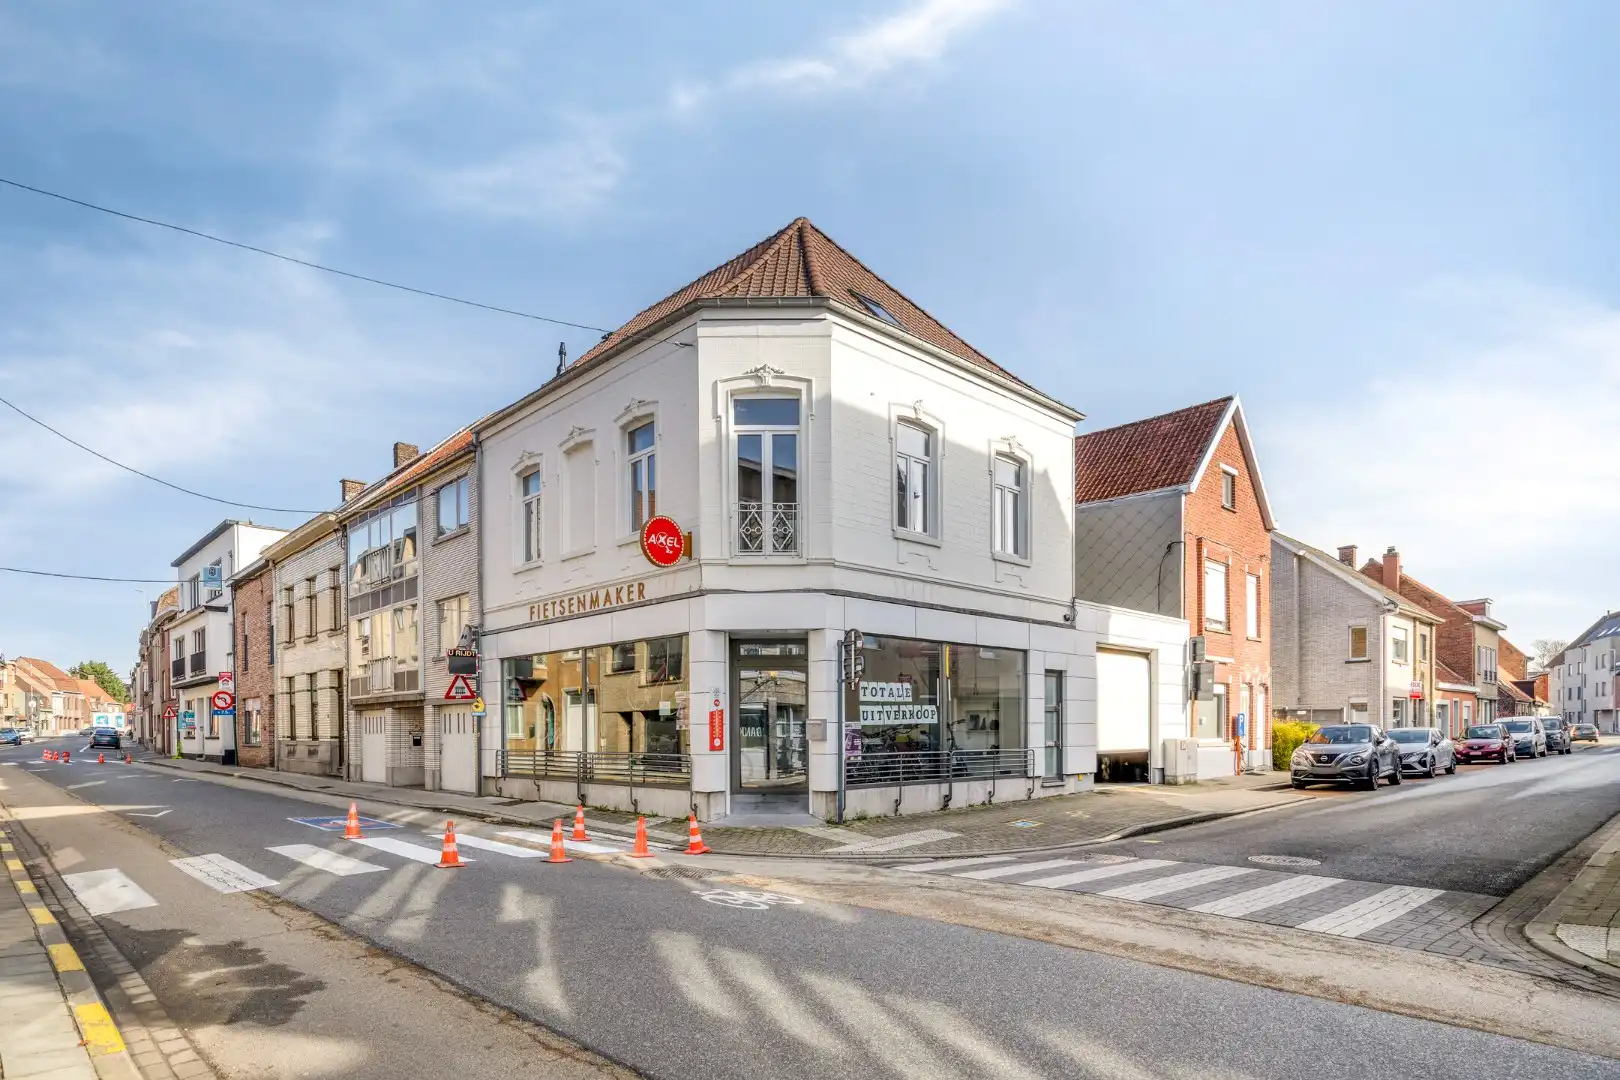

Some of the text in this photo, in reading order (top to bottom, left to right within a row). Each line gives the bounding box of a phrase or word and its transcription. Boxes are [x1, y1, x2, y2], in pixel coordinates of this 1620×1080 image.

[648, 533, 680, 548] AXEL
[530, 582, 645, 621] FIETSENMAKER
[861, 686, 912, 698] TOTALE
[862, 708, 936, 721] UITVERKOOP
